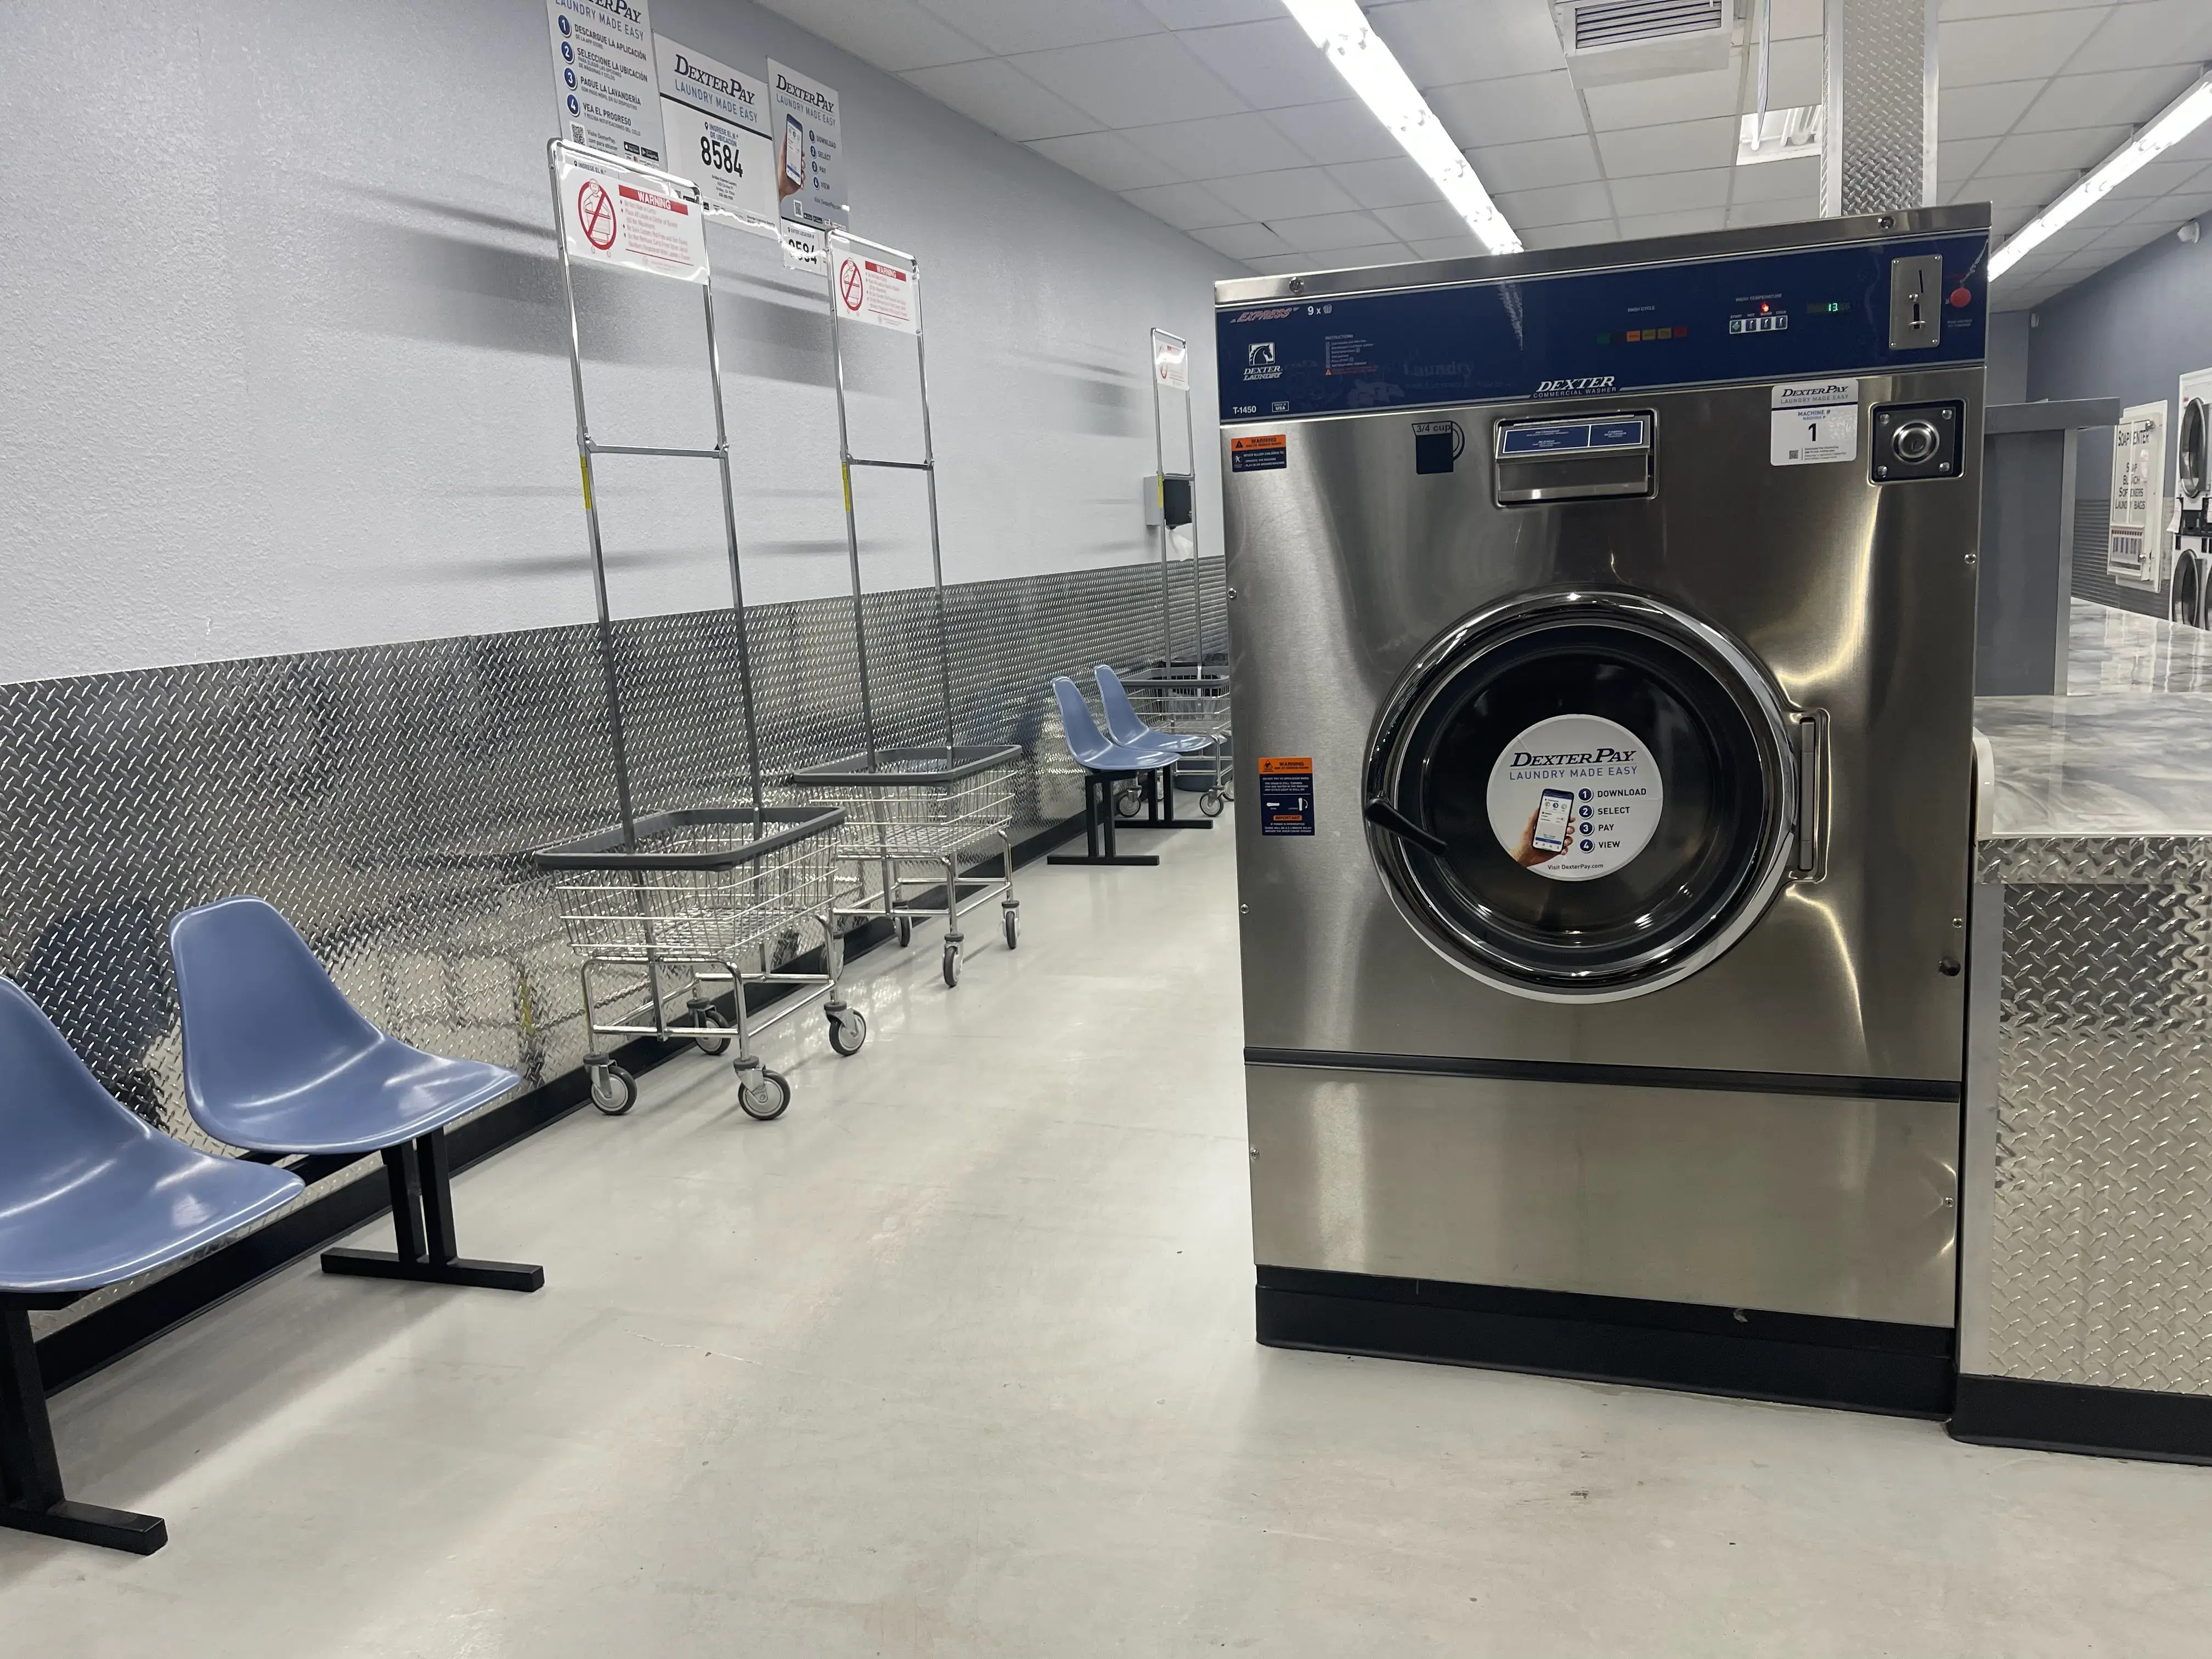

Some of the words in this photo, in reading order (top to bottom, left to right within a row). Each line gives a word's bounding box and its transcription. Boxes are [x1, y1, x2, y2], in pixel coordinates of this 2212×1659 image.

[599, 12, 622, 32] MADE
[625, 24, 644, 41] EASY
[561, 19, 566, 31] 1
[574, 24, 607, 44] DESCARGUE
[608, 38, 616, 47] LA
[616, 41, 647, 61] APLICACIÓN
[565, 46, 570, 58] 2
[577, 47, 611, 68] SELECCIONE
[612, 61, 619, 71] LA
[620, 65, 648, 82] UBICACIÓN
[567, 72, 573, 83] 3
[581, 76, 599, 90] PAGUE
[600, 83, 607, 92] LA
[608, 86, 641, 105] LAVANDERÍA
[675, 78, 713, 105] LAUNDRY
[716, 95, 737, 115] MADE
[740, 108, 758, 123] EASY
[571, 99, 575, 110] 4
[583, 102, 594, 113] VEA
[595, 106, 602, 116] EL
[603, 109, 631, 126] PROGRESO
[776, 93, 804, 112] LAUNDRY
[805, 106, 821, 121] MADE
[823, 114, 836, 126] EASY
[816, 135, 836, 149] DOWNLOAD
[701, 136, 743, 178] 8584
[818, 151, 831, 161] SELECT
[821, 181, 830, 190] VIEW
[637, 191, 671, 211] WARNING
[877, 264, 896, 279] WARNING
[1307, 305, 1314, 316] 9
[1828, 303, 1838, 312] 13
[1237, 307, 1292, 323] EXPRESS
[1243, 373, 1282, 381] LAUNDRY
[1244, 366, 1280, 375] DEXTER
[1536, 376, 1615, 392] DEXTER
[1533, 390, 1582, 399] COMMERCIAL
[1233, 405, 1257, 414] T-1450
[1417, 424, 1430, 433] 3/4
[1808, 423, 1816, 442] 1
[2118, 430, 2130, 447] SOAP
[2132, 429, 2149, 445] ENTER
[2126, 462, 2137, 472] SAP
[2123, 475, 2140, 484] BLACH
[2119, 487, 2143, 497] SOFENERS
[2134, 500, 2145, 509] BAGS
[1510, 770, 1565, 780] LAUNDRY
[1570, 768, 1603, 777] MADE
[1609, 765, 1637, 776] EASY
[1598, 788, 1646, 798] DOWNLOAD
[1598, 806, 1630, 815] SELECT
